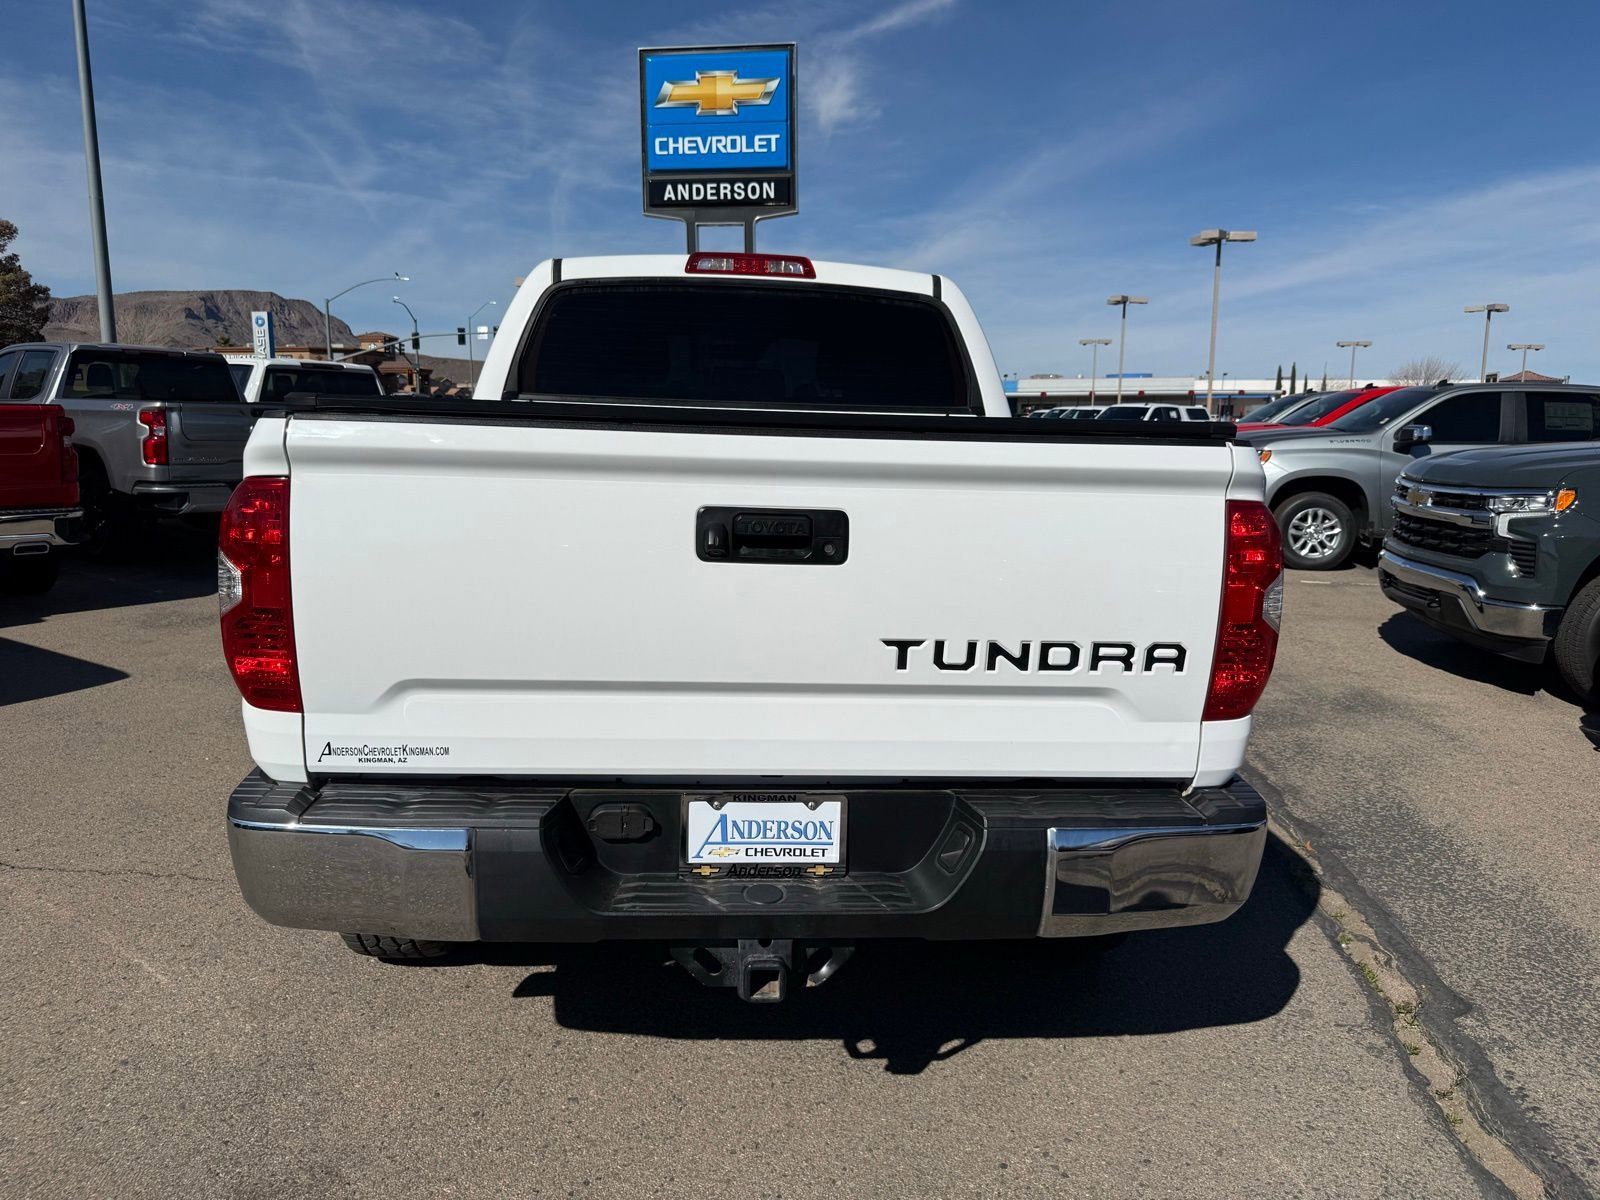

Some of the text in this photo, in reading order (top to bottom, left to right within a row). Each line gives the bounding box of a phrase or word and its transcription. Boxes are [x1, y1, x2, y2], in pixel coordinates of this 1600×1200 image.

[654, 134, 781, 155] CHEVROLET
[663, 182, 775, 201] ANDERSON
[741, 520, 808, 535] TOYOTA
[879, 638, 1187, 674] TUNDRA
[733, 794, 797, 802] KINGMAN
[692, 813, 834, 858] ANDERSON
[745, 847, 829, 858] CHEVROLET
[726, 864, 802, 878] Anderson
